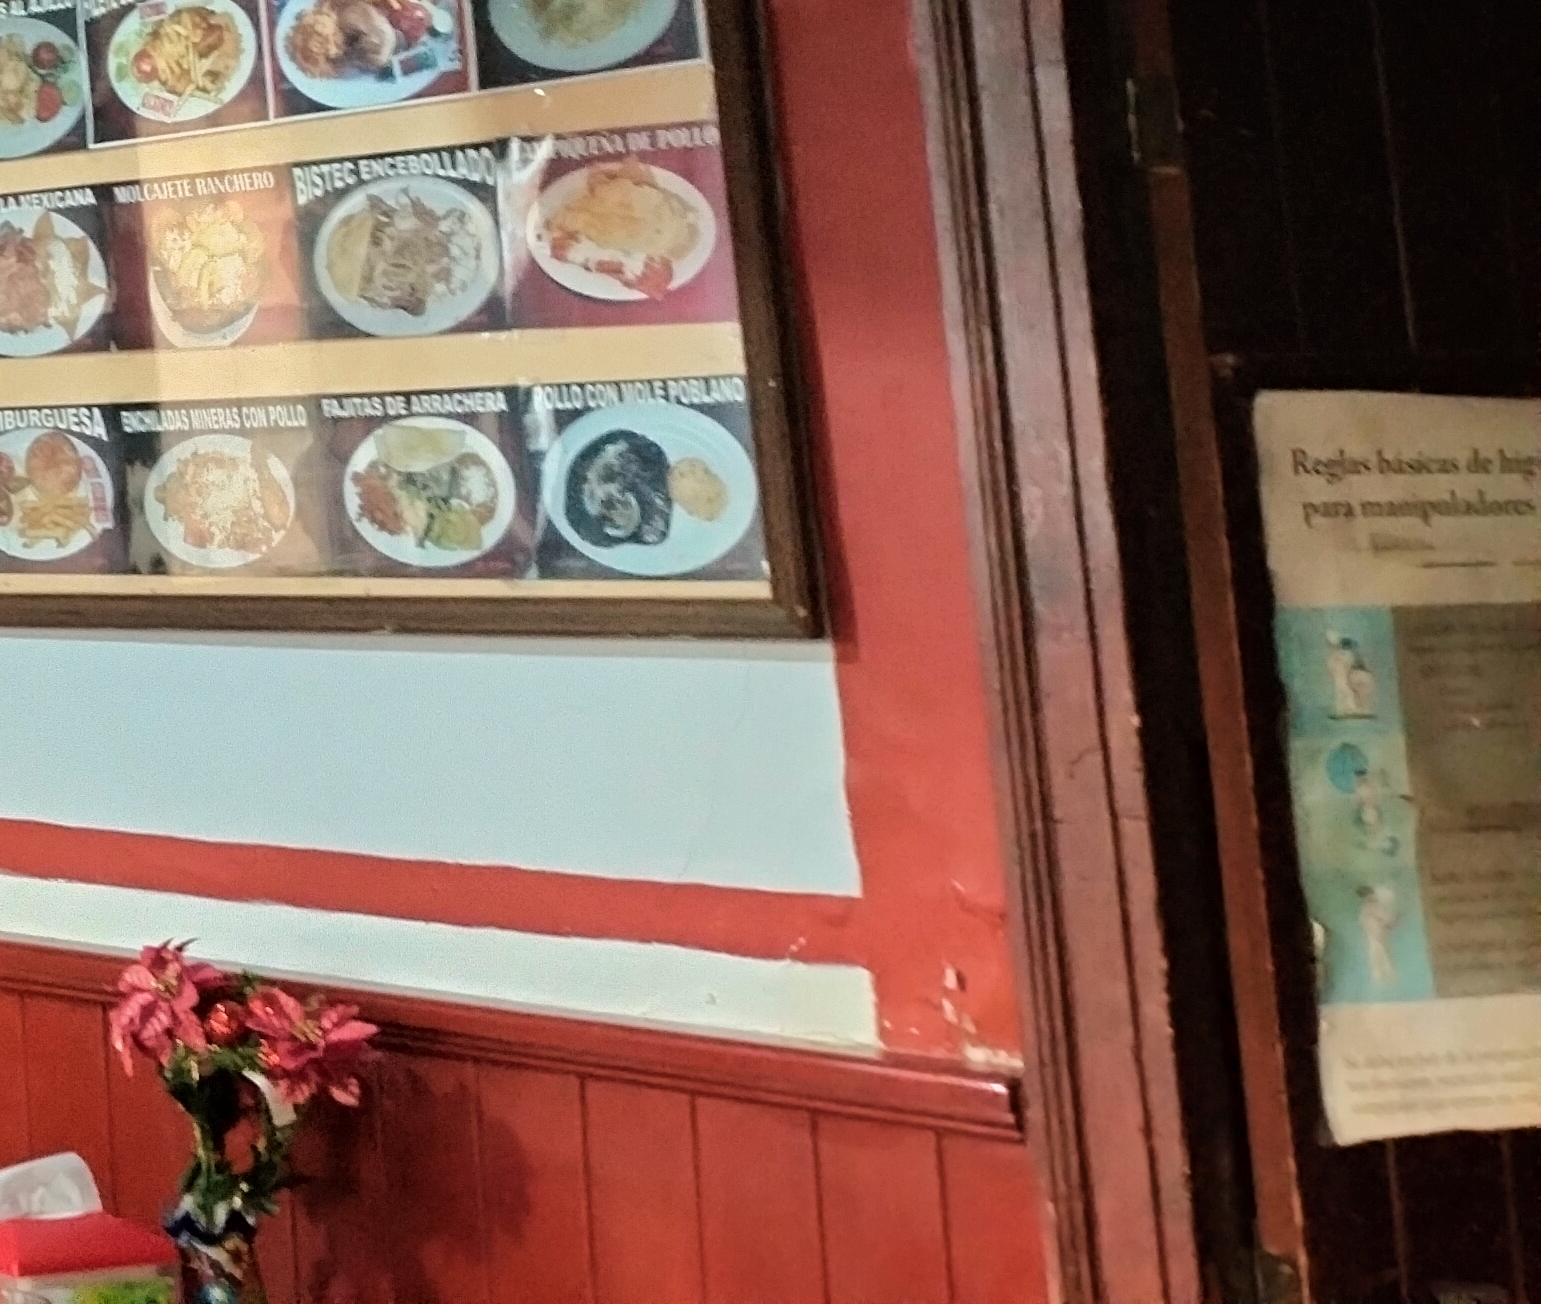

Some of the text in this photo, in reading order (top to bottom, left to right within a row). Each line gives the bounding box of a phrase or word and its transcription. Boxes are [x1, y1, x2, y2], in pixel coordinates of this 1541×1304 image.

[9, 0, 27, 16] AL
[655, 124, 719, 150] POLLO
[112, 170, 275, 204] MOLCAJETE RANCHERO
[292, 147, 496, 206] BISTEC ENCEBOLLADO
[19, 187, 98, 211] MEXICANA
[320, 390, 509, 418] FAJITAS DE ARRACHERA
[532, 383, 583, 410] POLLO
[583, 381, 620, 408] CON
[667, 376, 746, 405] POBLANO
[120, 404, 309, 434] ENCHILADAS MINERAS CON POLLO
[1291, 447, 1371, 485] Reglas
[1466, 448, 1494, 474] de
[1302, 501, 1356, 529] para
